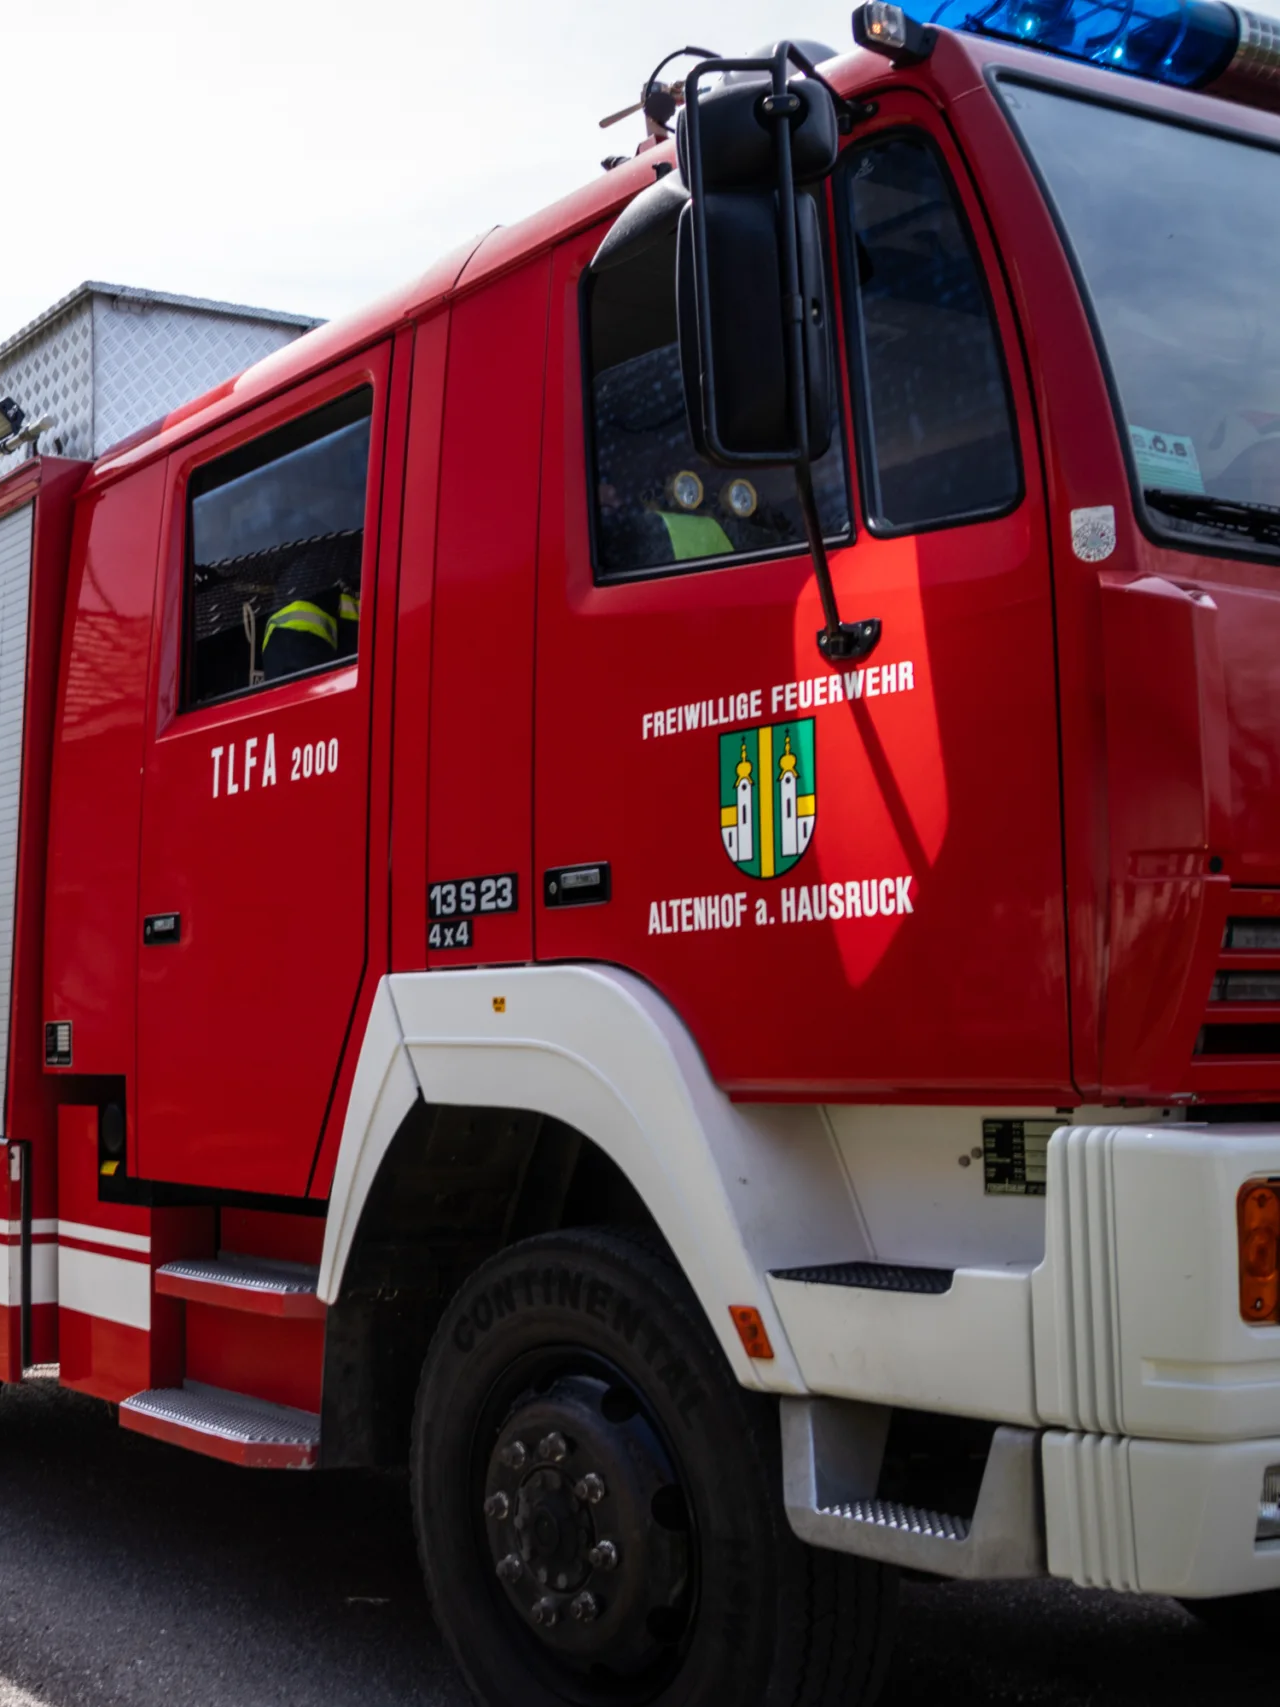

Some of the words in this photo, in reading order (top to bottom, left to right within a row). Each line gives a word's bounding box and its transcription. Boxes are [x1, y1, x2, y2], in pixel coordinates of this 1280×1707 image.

[642, 689, 763, 741] FREIWILLIGE
[770, 659, 916, 715] FEUERWEHR
[210, 732, 277, 799] TLFA
[290, 737, 339, 782] 2000
[428, 920, 470, 948] 4x4
[647, 891, 748, 936] ALTENHOF
[754, 900, 776, 926] a.
[780, 875, 916, 925] HAUSRUCK
[451, 1266, 710, 1432] CONTINENTAL
